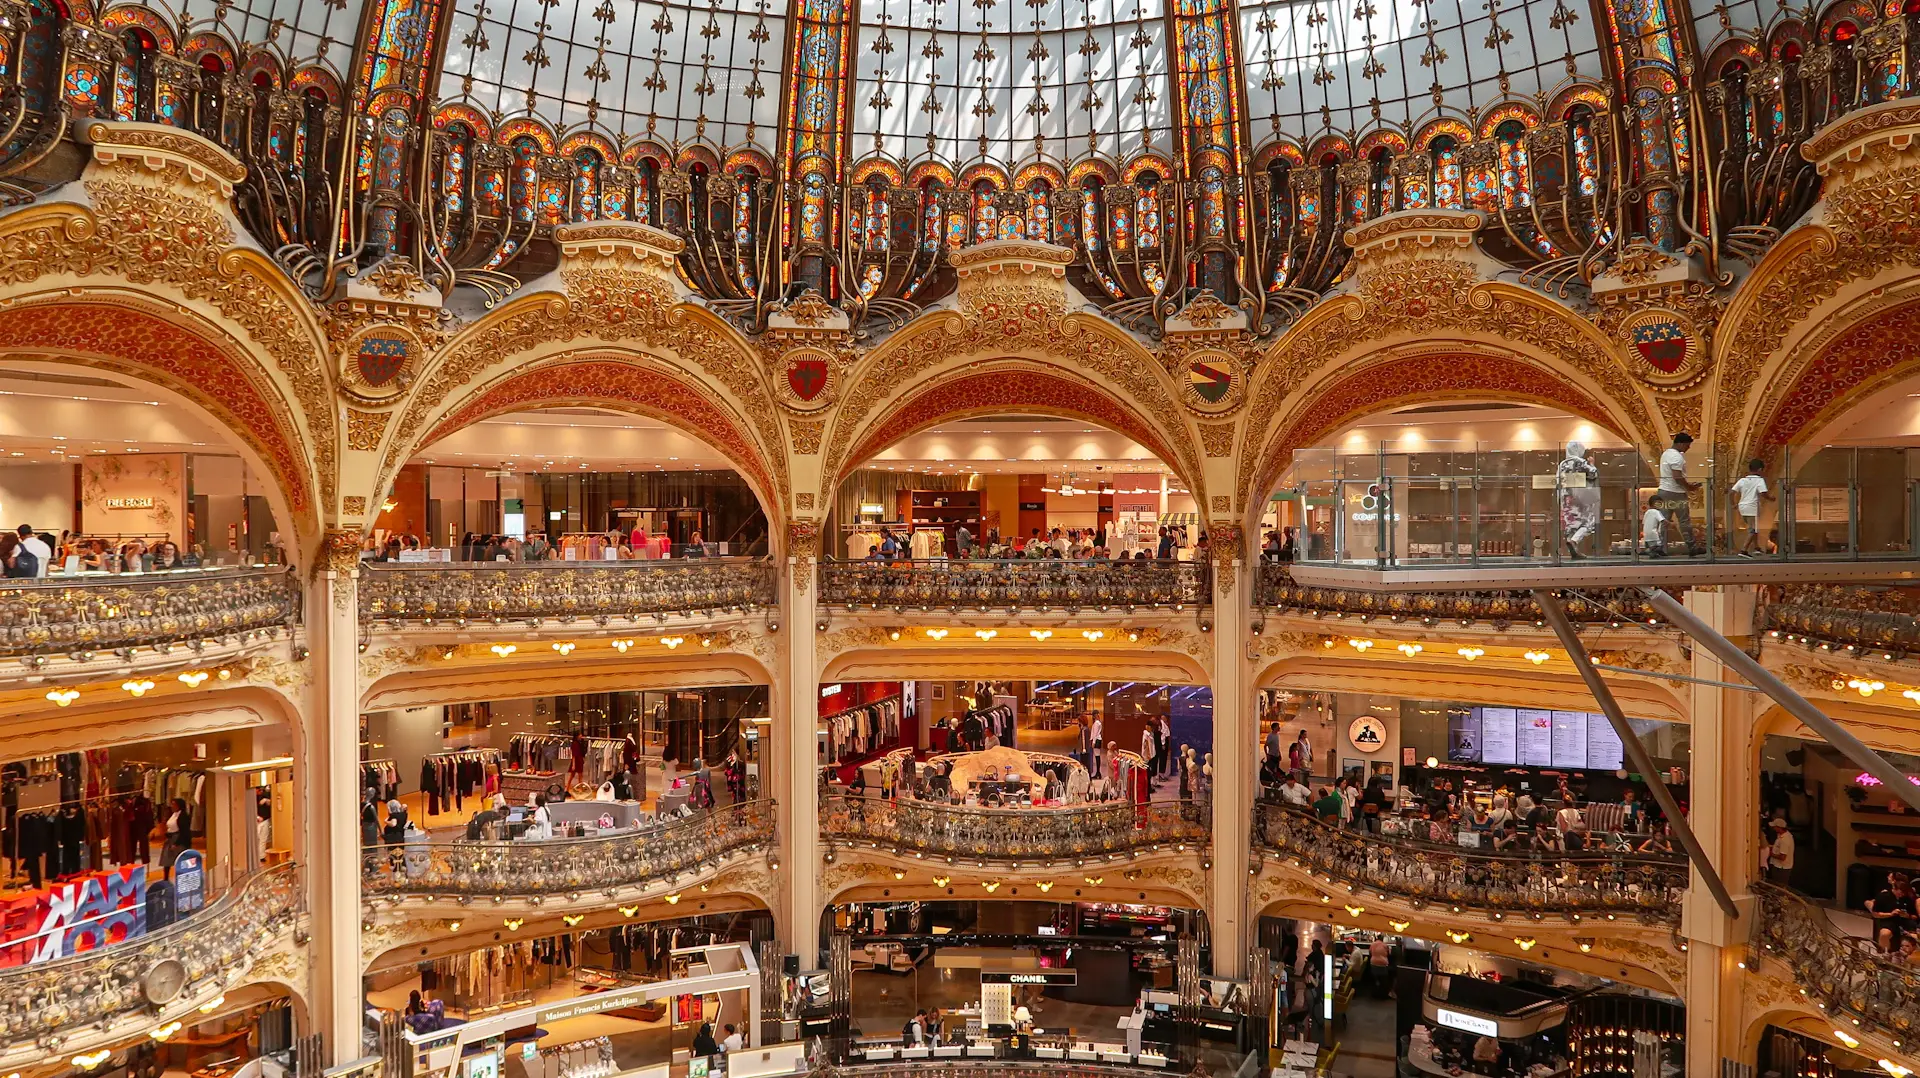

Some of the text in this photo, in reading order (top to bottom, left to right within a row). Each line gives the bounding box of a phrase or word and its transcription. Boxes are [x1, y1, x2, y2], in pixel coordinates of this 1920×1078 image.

[1010, 975, 1047, 983] CHANEL
[545, 997, 638, 1021] Maison Francis Kurkdjian
[1454, 1017, 1489, 1030] WINE GATE
